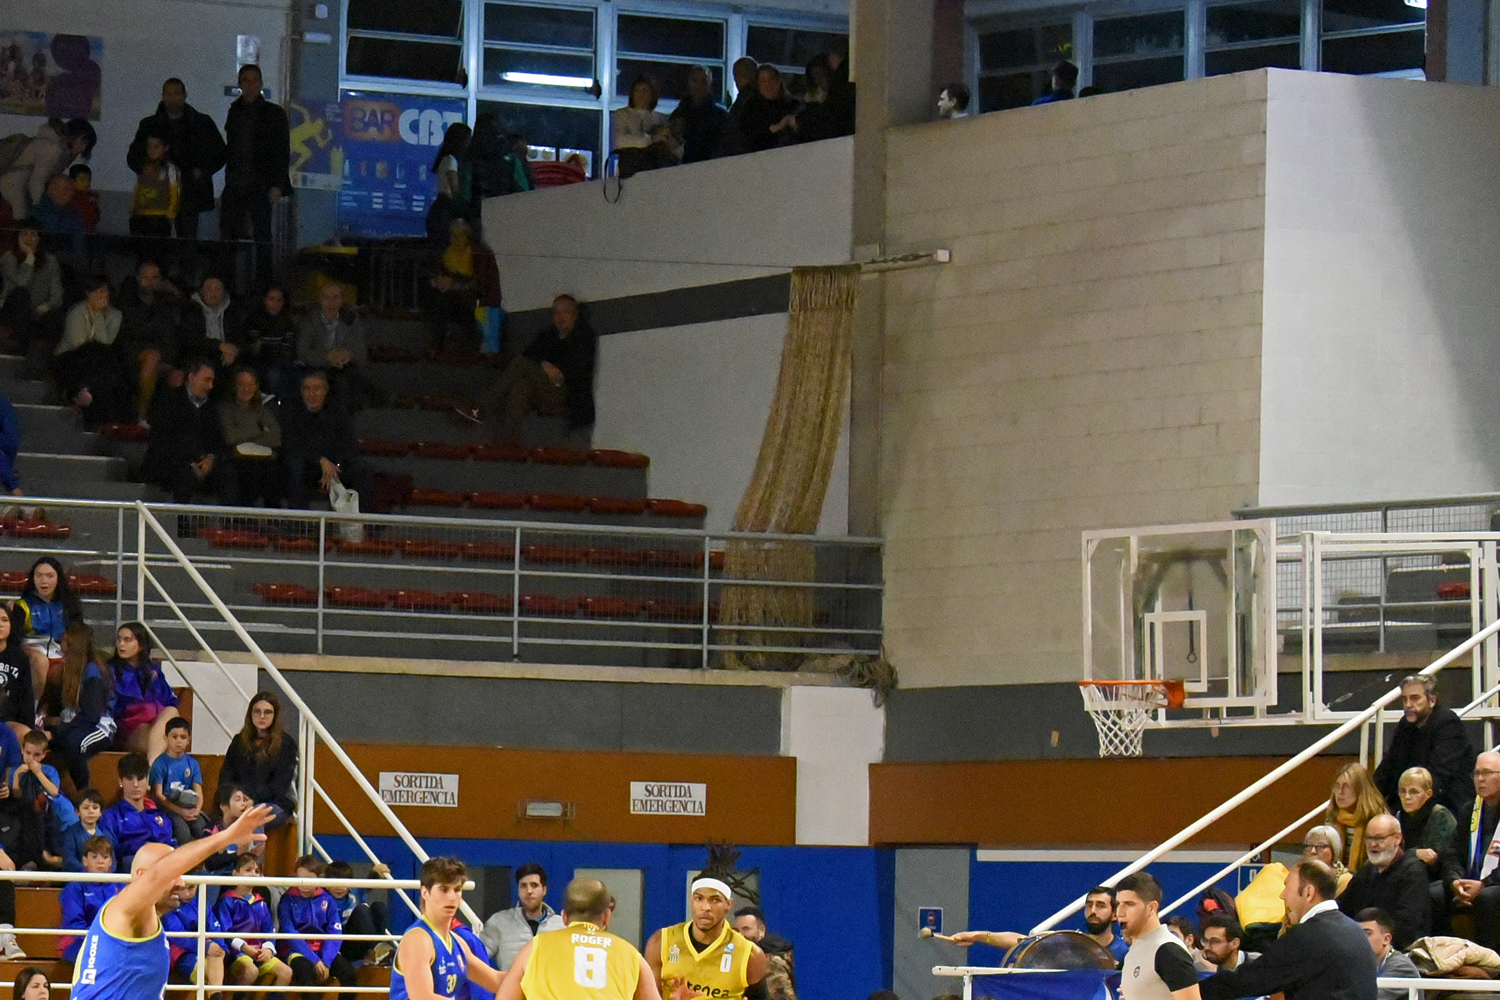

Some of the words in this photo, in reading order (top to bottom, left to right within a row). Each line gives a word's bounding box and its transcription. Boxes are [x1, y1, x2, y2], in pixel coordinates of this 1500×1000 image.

[352, 107, 393, 131] BAR
[399, 108, 463, 147] CBT
[393, 774, 444, 790] SORTIDA
[380, 789, 457, 806] EMERGENCIA
[644, 783, 693, 799] SORTIDA
[631, 799, 705, 815] EMERGENCIA
[571, 933, 612, 948] ROGER
[574, 946, 608, 989] 8
[720, 953, 733, 973] 0
